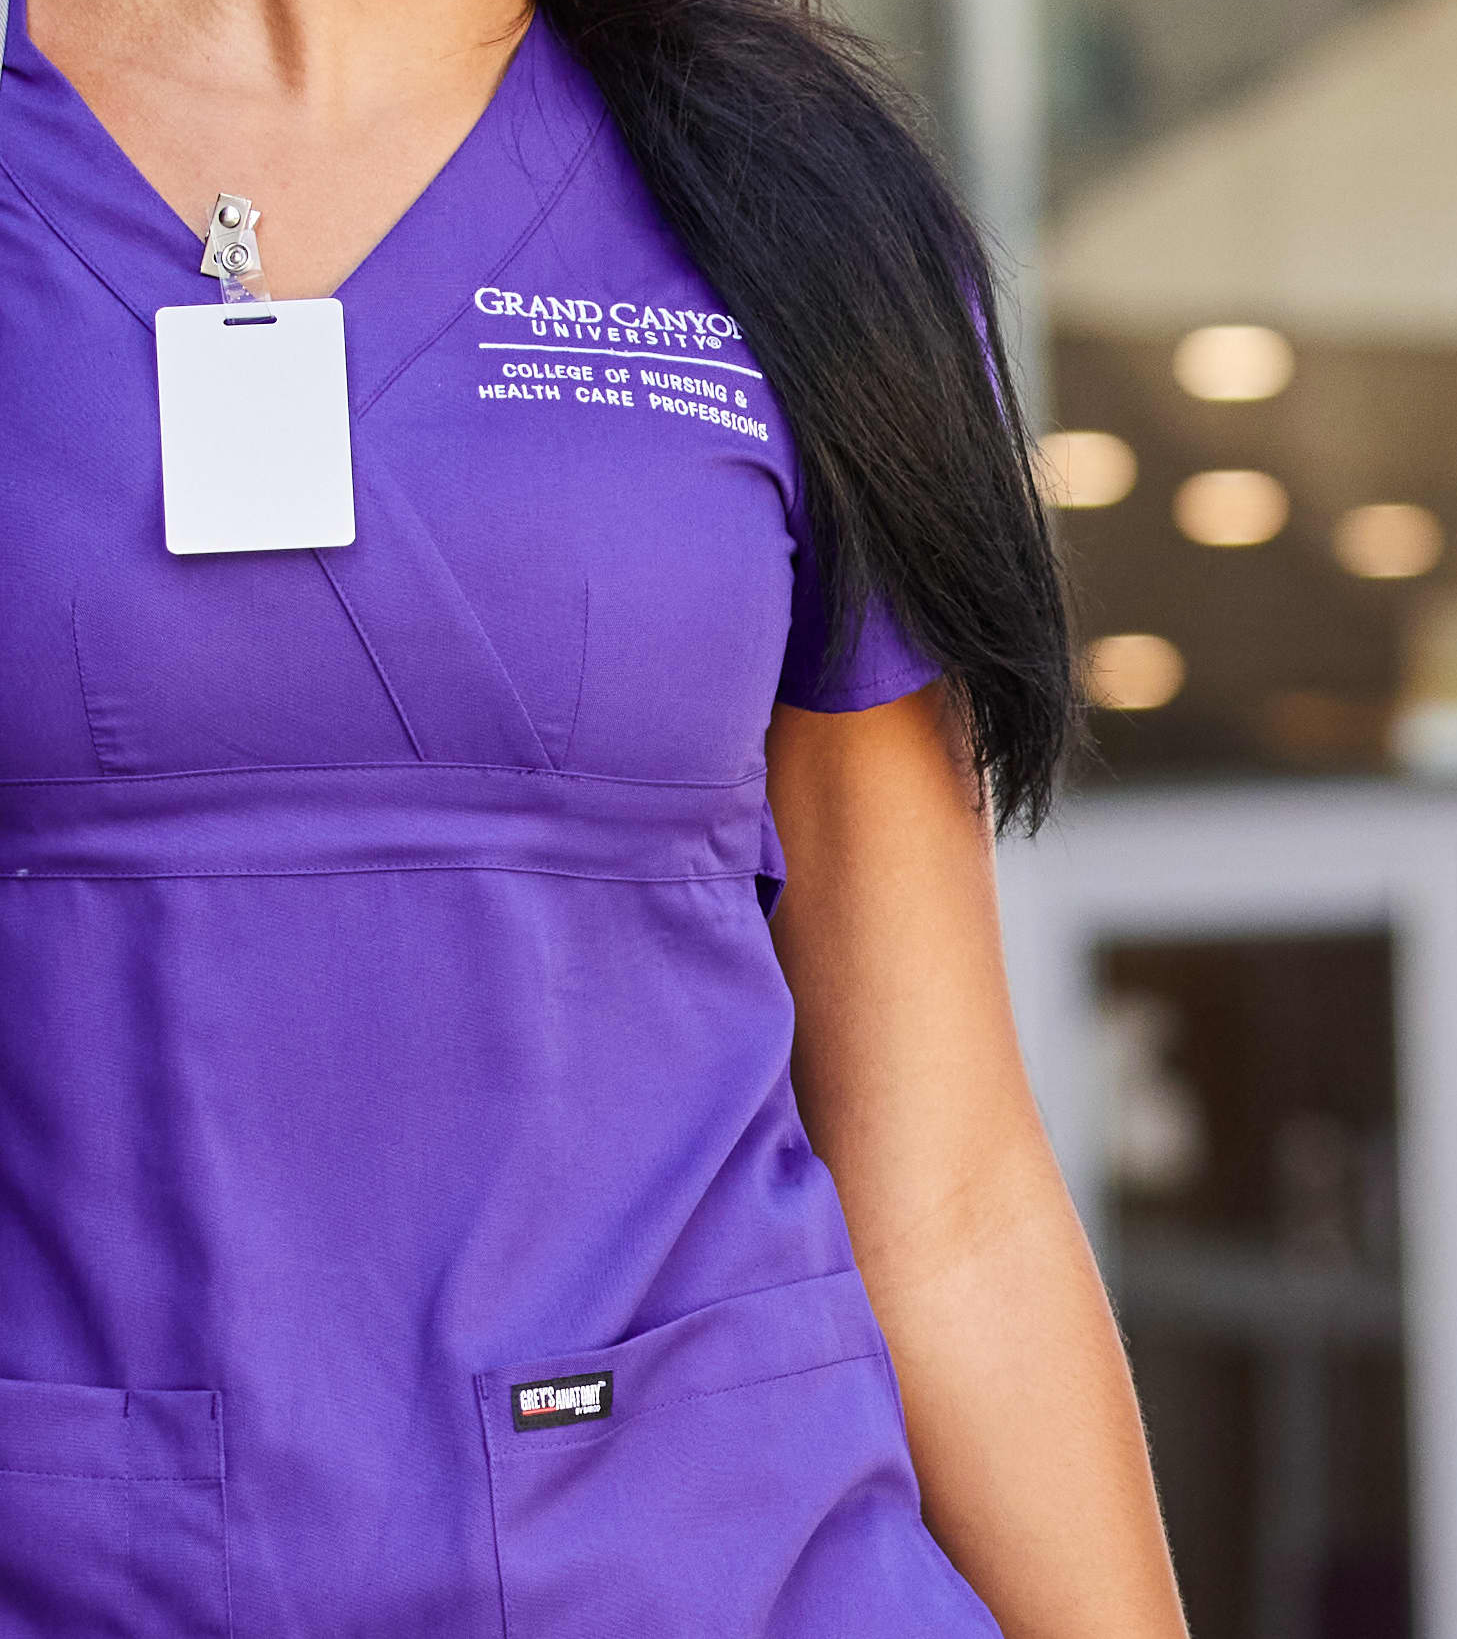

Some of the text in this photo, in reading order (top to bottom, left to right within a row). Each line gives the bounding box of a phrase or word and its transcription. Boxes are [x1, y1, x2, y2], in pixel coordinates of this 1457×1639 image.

[475, 288, 602, 323] GRAND
[503, 363, 747, 408] COLLEGE OF NURSING &
[479, 384, 768, 441] HEALTH CARE PROFESSIONS
[520, 1386, 556, 1411] GREY'S
